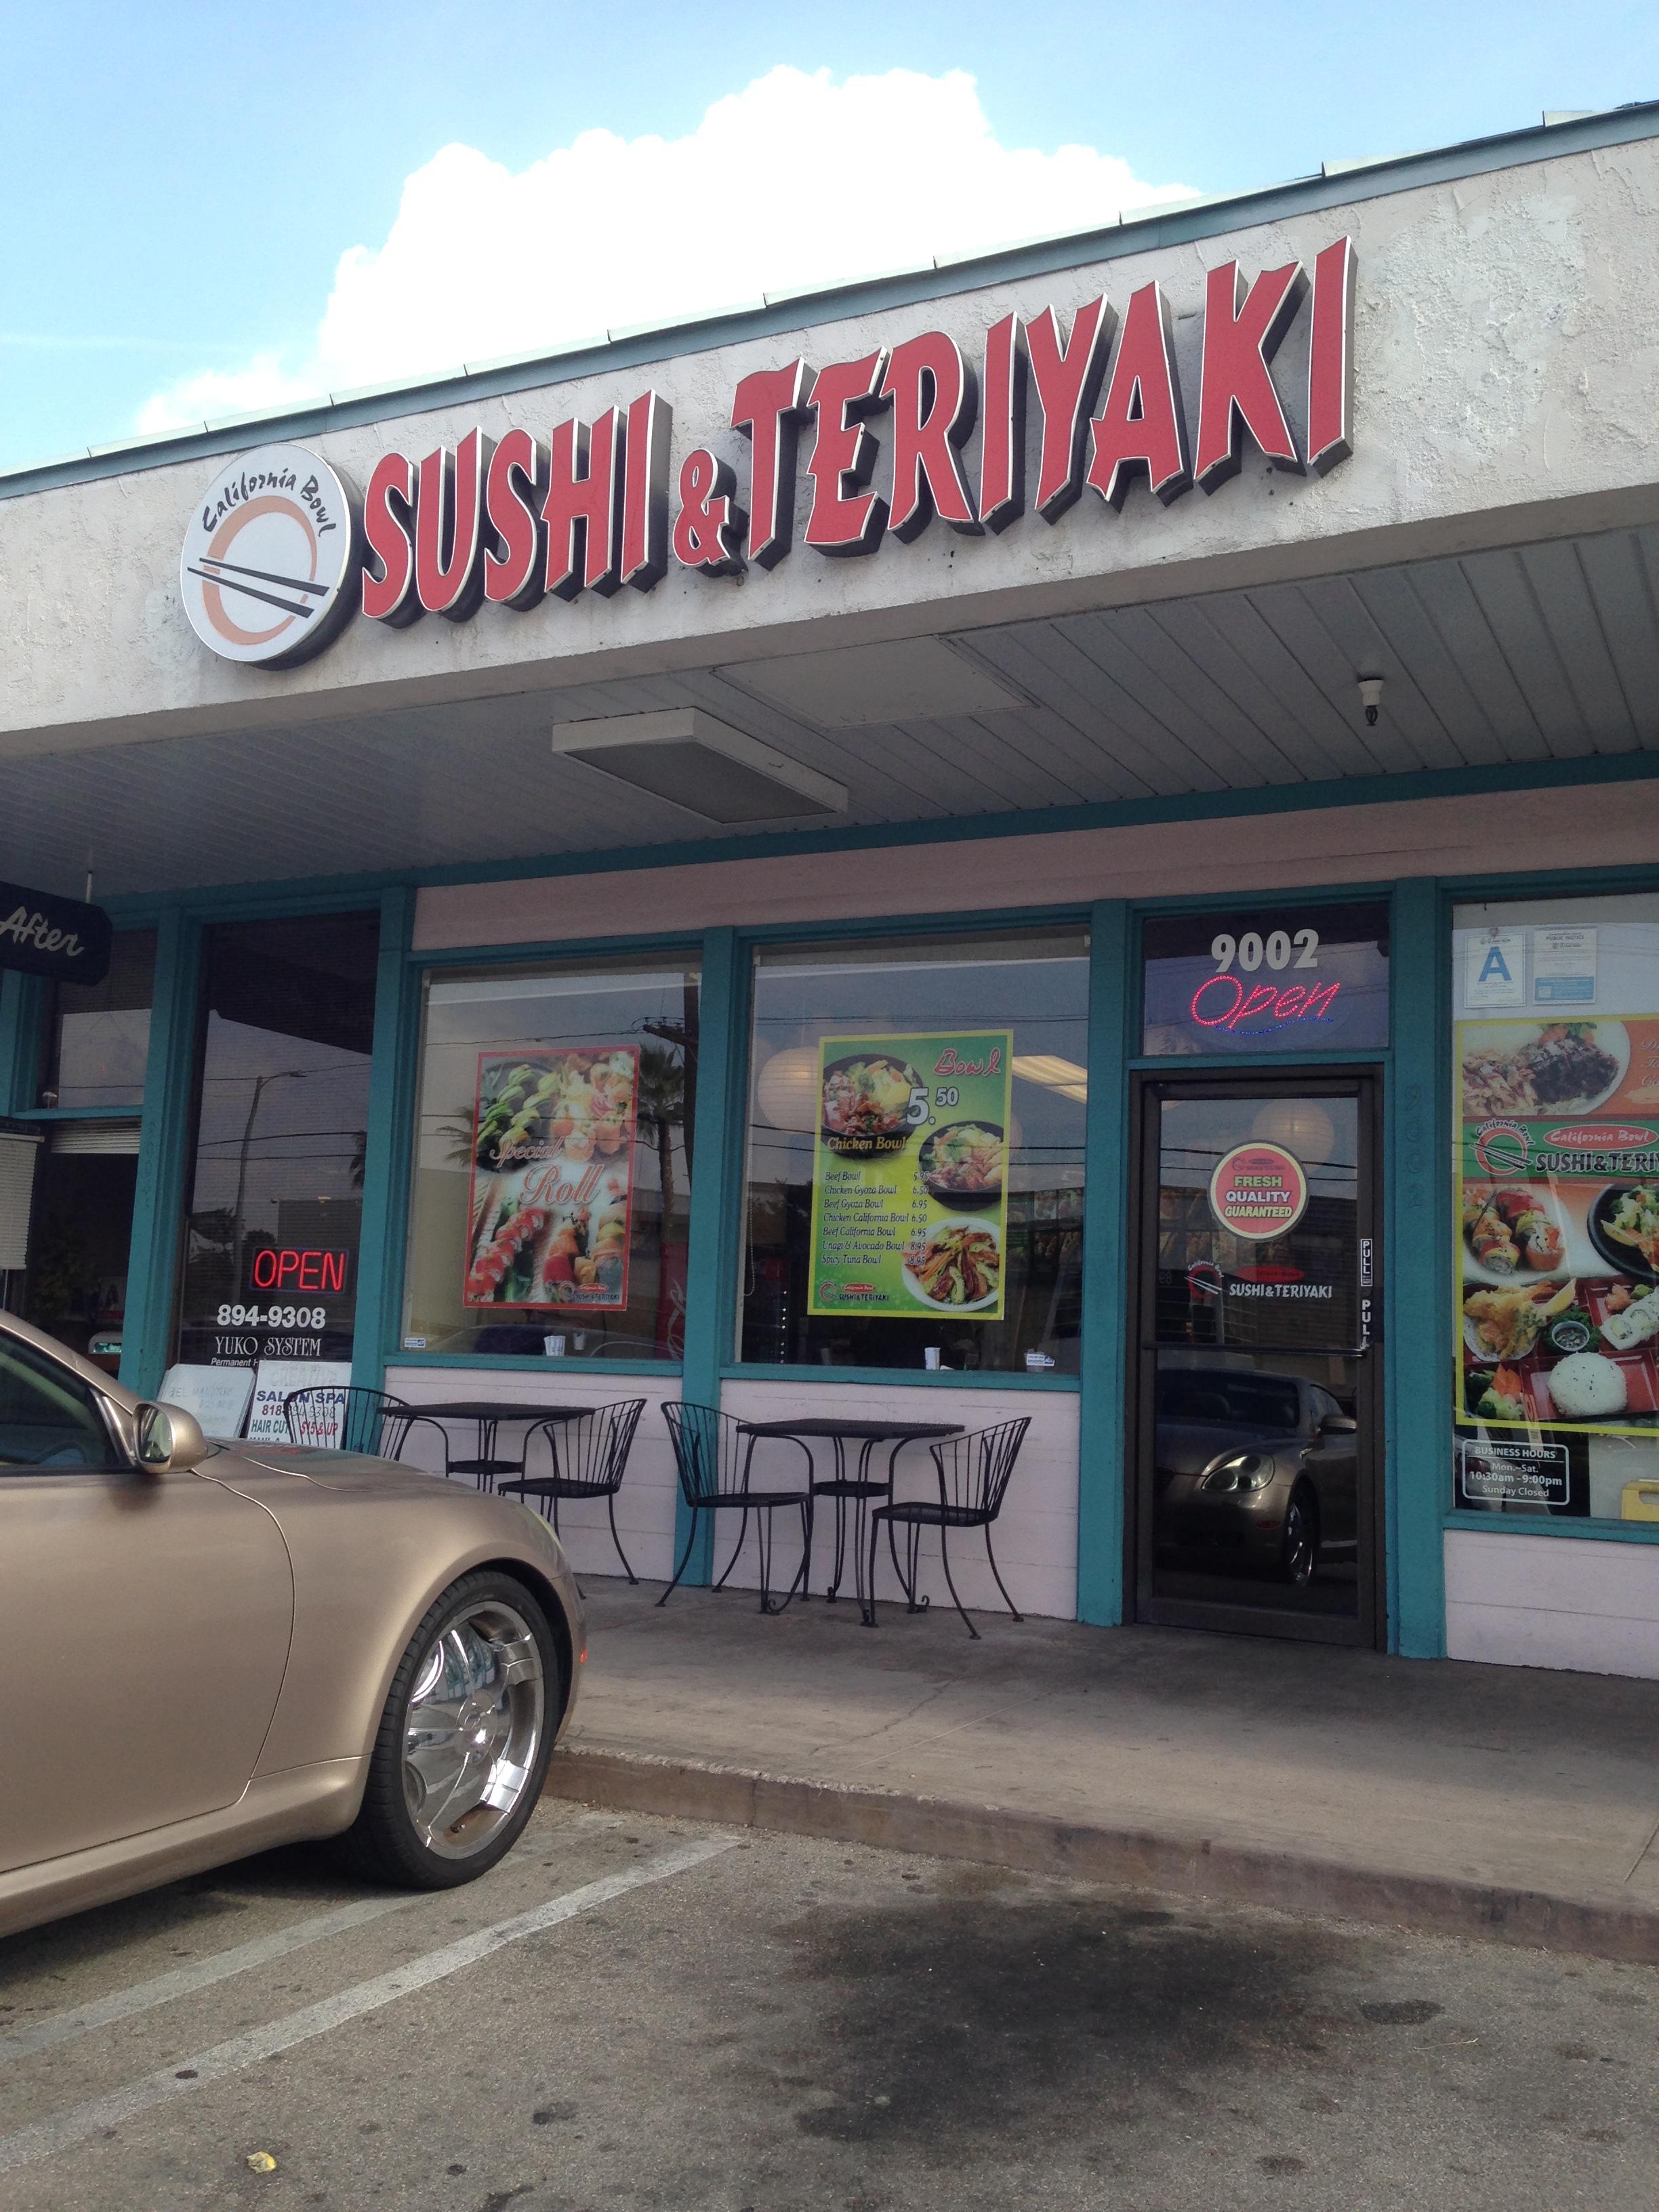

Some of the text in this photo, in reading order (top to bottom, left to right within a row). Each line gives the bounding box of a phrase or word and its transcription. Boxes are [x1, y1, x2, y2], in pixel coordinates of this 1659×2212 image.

[361, 234, 1357, 628] SUSHI & TERIYAKI
[202, 467, 337, 537] California Bowl
[0, 905, 85, 956] After
[1211, 928, 1319, 974] 9002
[1478, 945, 1513, 983] A
[1191, 975, 1340, 1029] Open
[933, 1048, 1002, 1076] Bowl
[1475, 1118, 1536, 1145] California Bowl
[1550, 1129, 1650, 1145] California Bowl
[827, 1136, 907, 1150] Chicken Bowl
[825, 1171, 841, 1182] Beef
[842, 1170, 861, 1181] Bowl
[1233, 1175, 1282, 1187] FRESH
[520, 1164, 605, 1205] Roll
[824, 1185, 853, 1194] Chicken
[854, 1185, 876, 1195] Gyoza
[878, 1185, 897, 1194] Bowl
[1225, 1190, 1291, 1203] QUALITY
[824, 1199, 927, 1210] Beef Gyoza Bowl 6.95
[1225, 1205, 1293, 1218] GUARANTEED
[823, 1212, 928, 1224] Chicken California Bowl 6.50
[823, 1227, 926, 1237] Beef California Bowl 6.95
[853, 1241, 884, 1250] Avocado
[886, 1241, 905, 1250] Bowl
[821, 1254, 840, 1265] Spicy
[842, 1254, 861, 1264] Tuna
[862, 1254, 882, 1264] Bowl
[1362, 1241, 1371, 1274] PULL
[254, 1250, 346, 1290] OPEN
[216, 1304, 327, 1329] 894-9308
[215, 1336, 322, 1357] YUKO SYSTEM
[211, 1357, 253, 1368] Permanent
[315, 1392, 346, 1404] SPA
[251, 1419, 272, 1433] HAIR
[326, 1422, 339, 1435] UP
[1475, 1446, 1556, 1459] BUSINESS HOURS
[1469, 1471, 1514, 1483] 10:30am
[1522, 1475, 1563, 1486] 9:00pm
[1482, 1485, 1549, 1498] Sunday Closed
